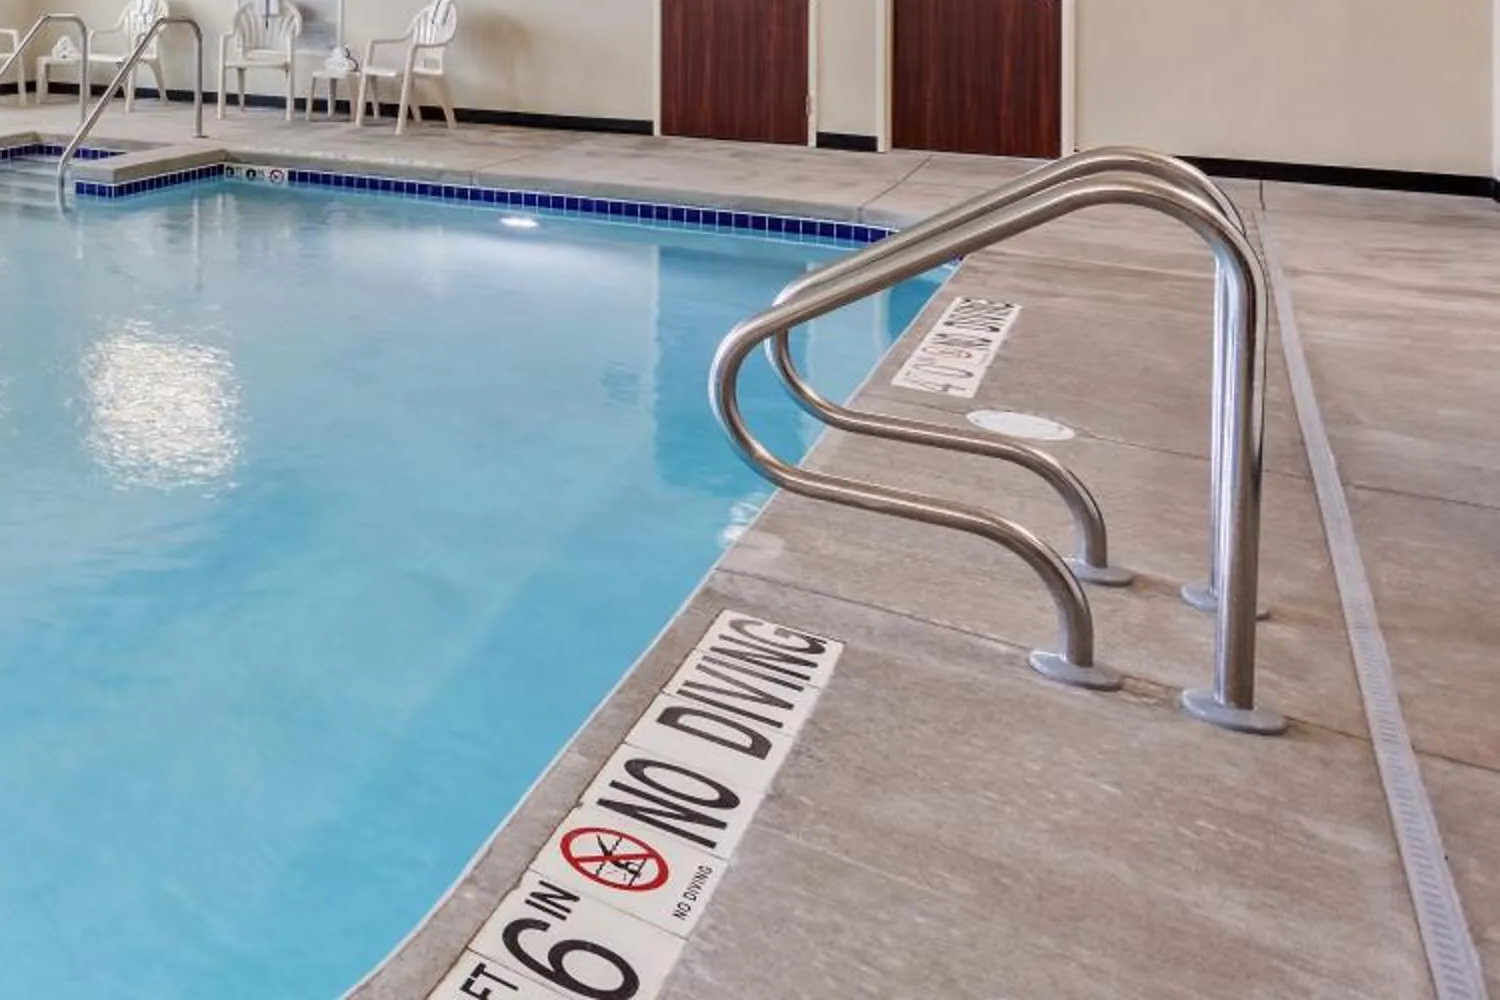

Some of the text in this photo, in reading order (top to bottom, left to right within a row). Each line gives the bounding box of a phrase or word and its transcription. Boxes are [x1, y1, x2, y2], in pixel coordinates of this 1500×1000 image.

[597, 618, 828, 849] NO DIVING
[525, 879, 581, 921] IN
[673, 865, 713, 921] NO DIVING
[502, 917, 640, 1000] 6
